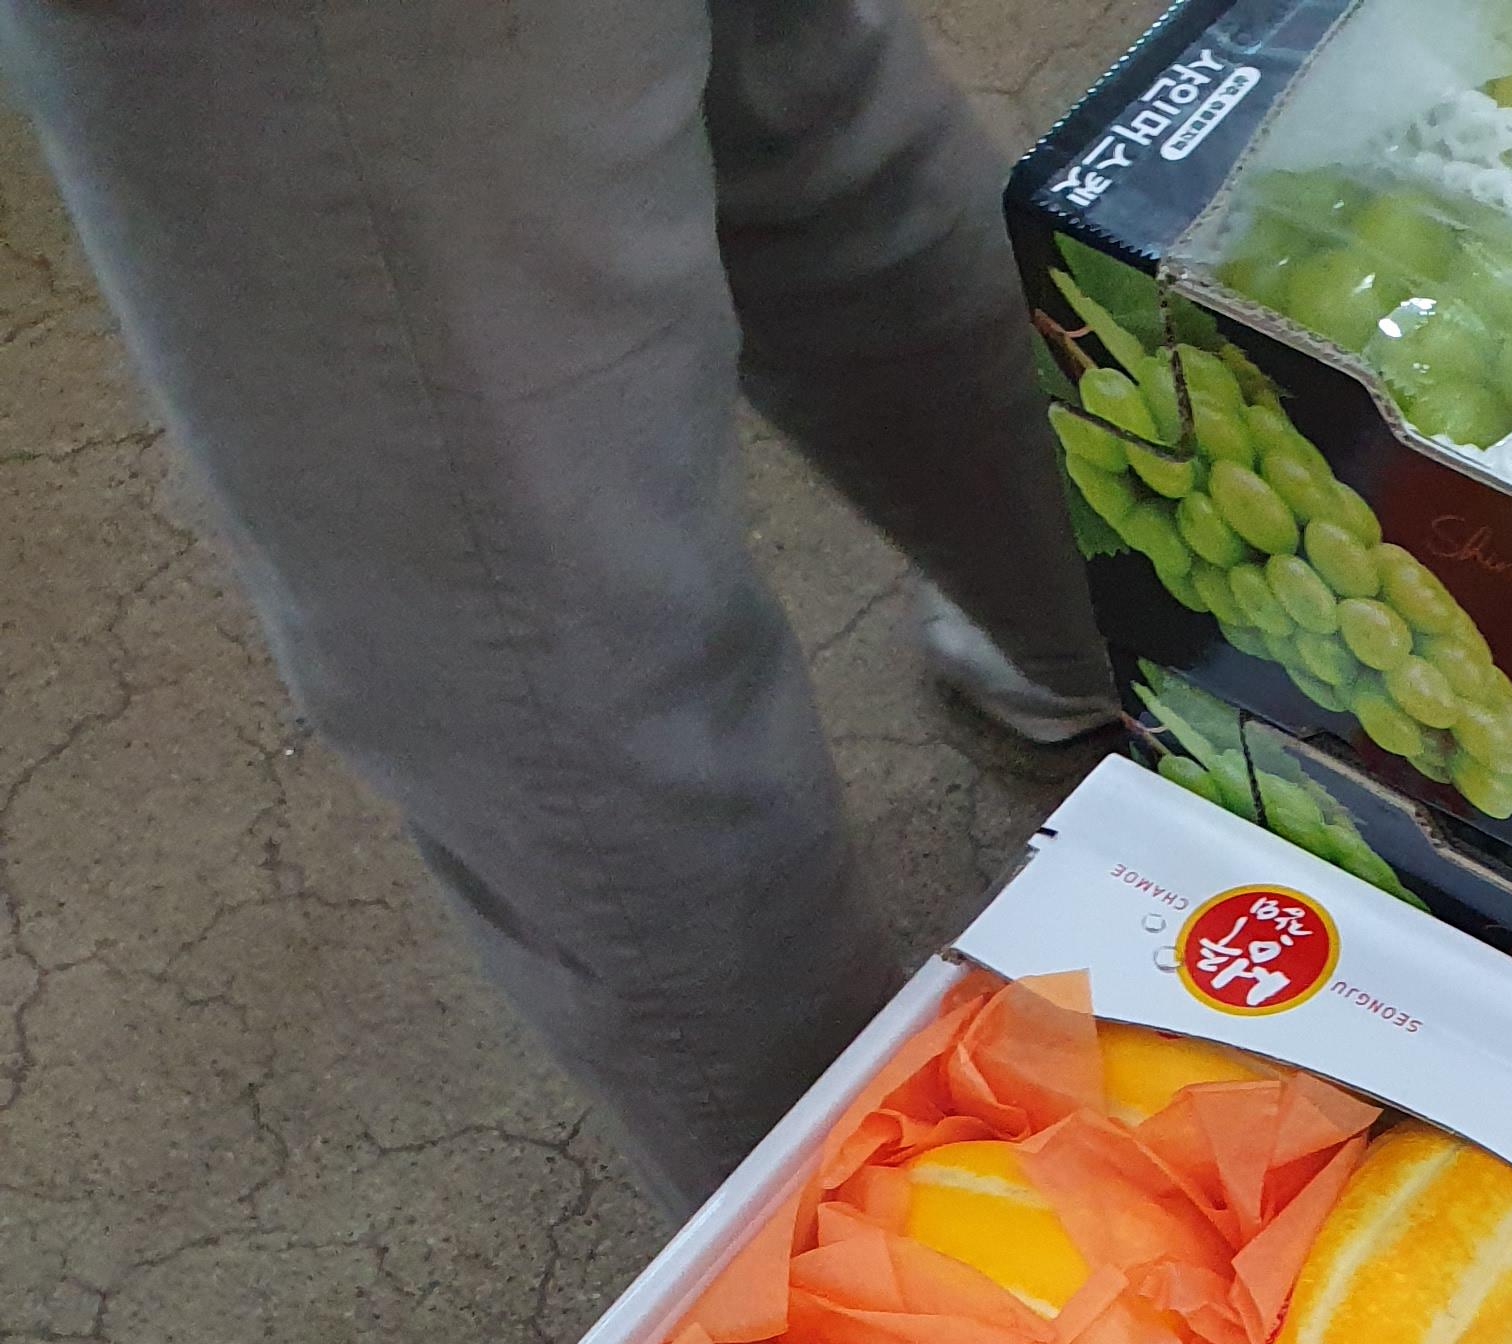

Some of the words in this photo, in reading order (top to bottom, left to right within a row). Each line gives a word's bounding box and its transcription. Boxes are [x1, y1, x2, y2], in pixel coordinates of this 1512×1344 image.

[1051, 49, 1226, 208] 샤인머스켓
[1109, 862, 1190, 912] CHAMOE
[1330, 979, 1425, 1034] SEONGJU
